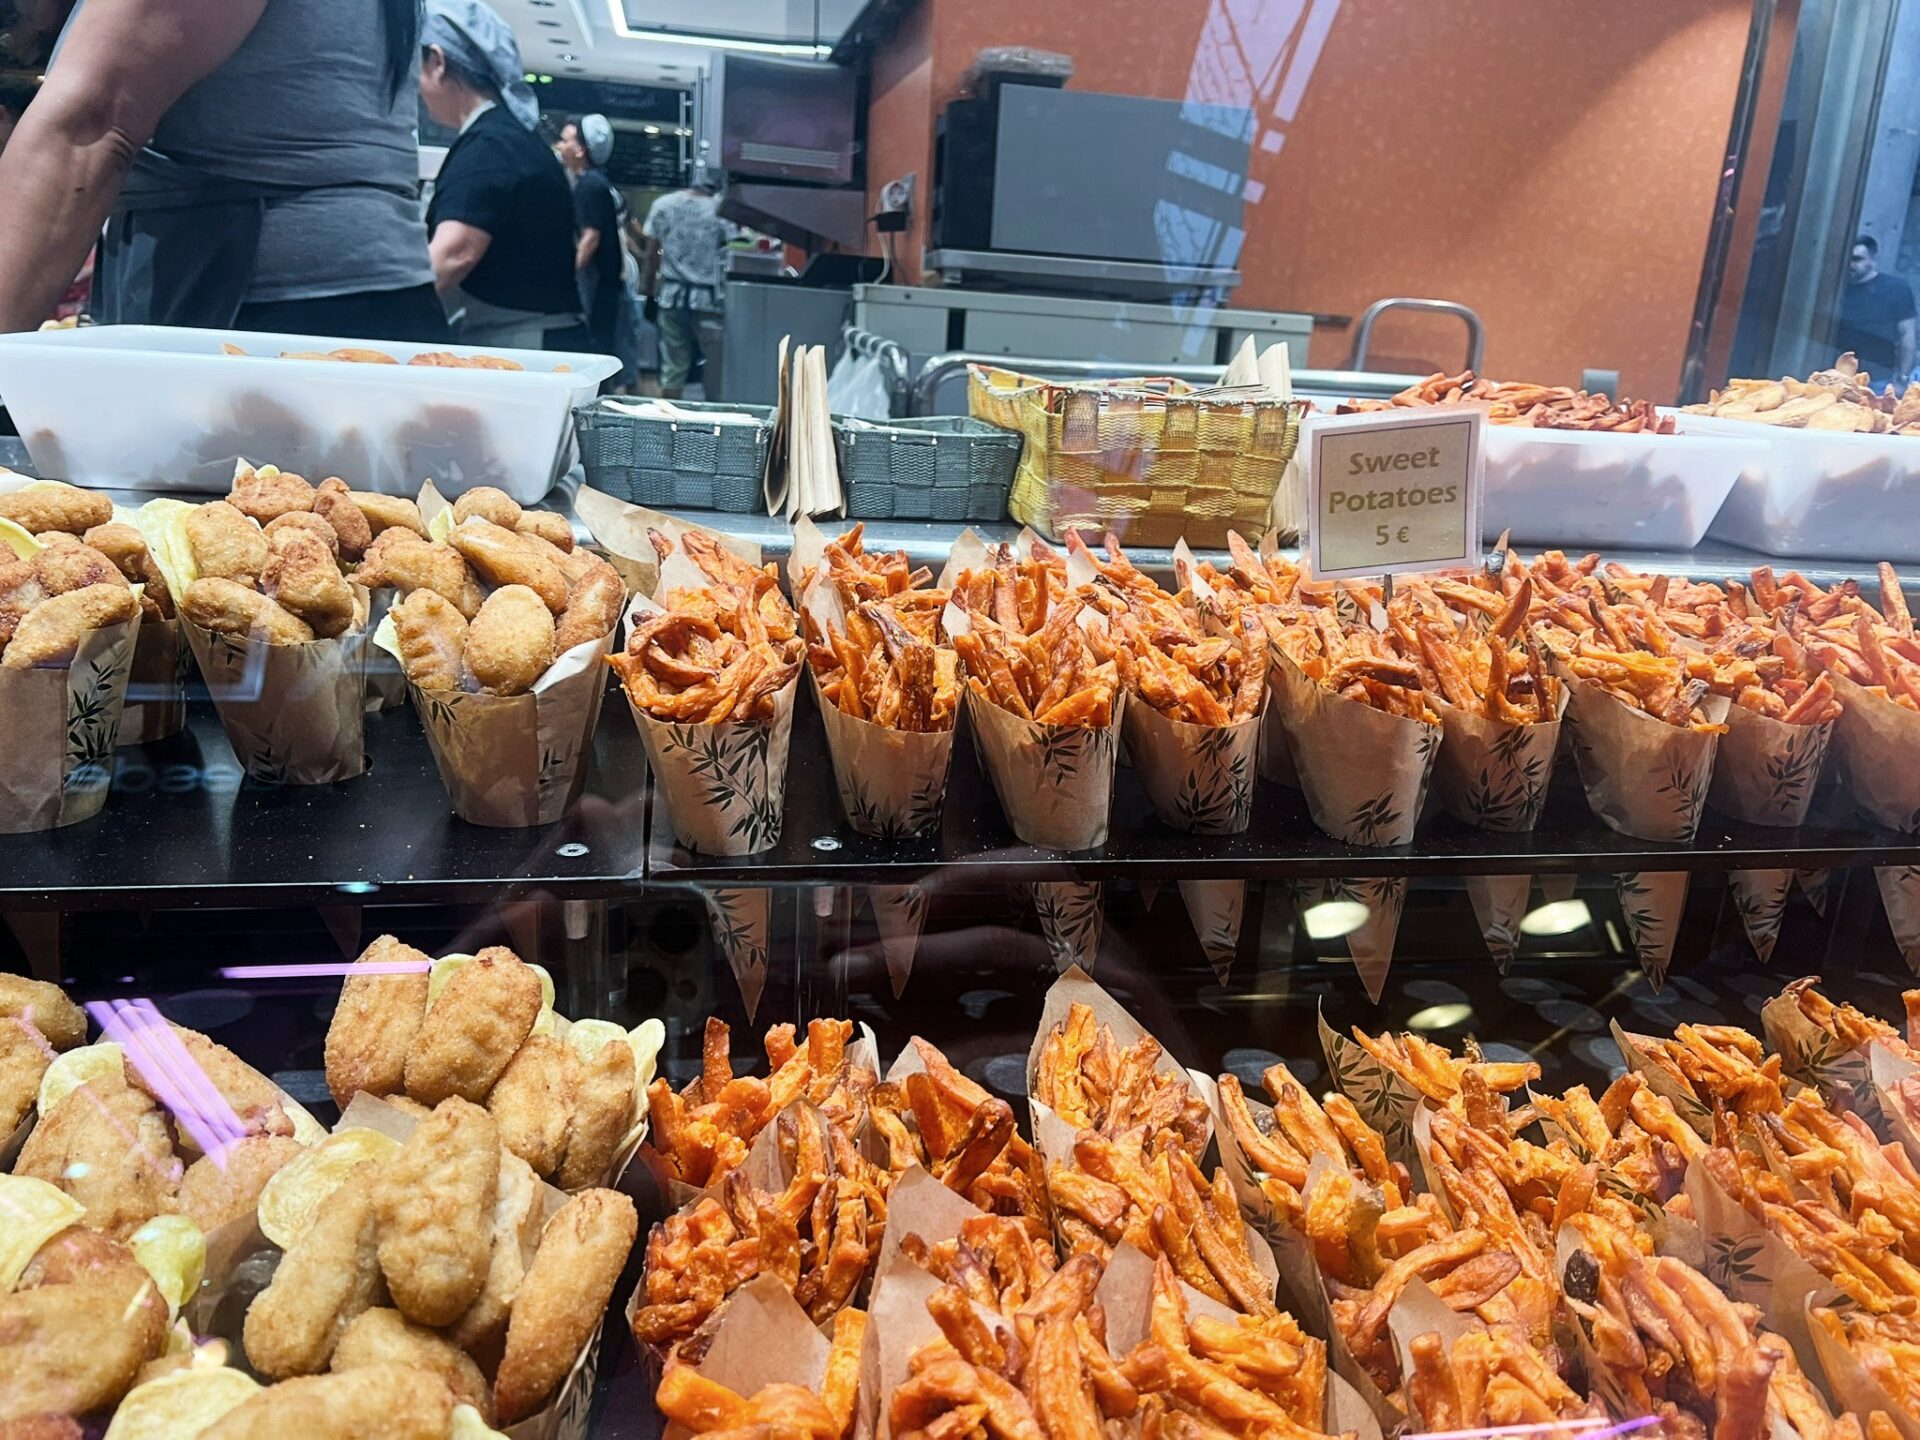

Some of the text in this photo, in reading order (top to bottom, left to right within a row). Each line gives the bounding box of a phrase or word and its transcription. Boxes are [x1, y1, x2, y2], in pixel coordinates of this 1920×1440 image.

[1348, 446, 1441, 476] Sweet
[1327, 484, 1458, 514] Potatoes
[1375, 525, 1410, 546] 5 €
